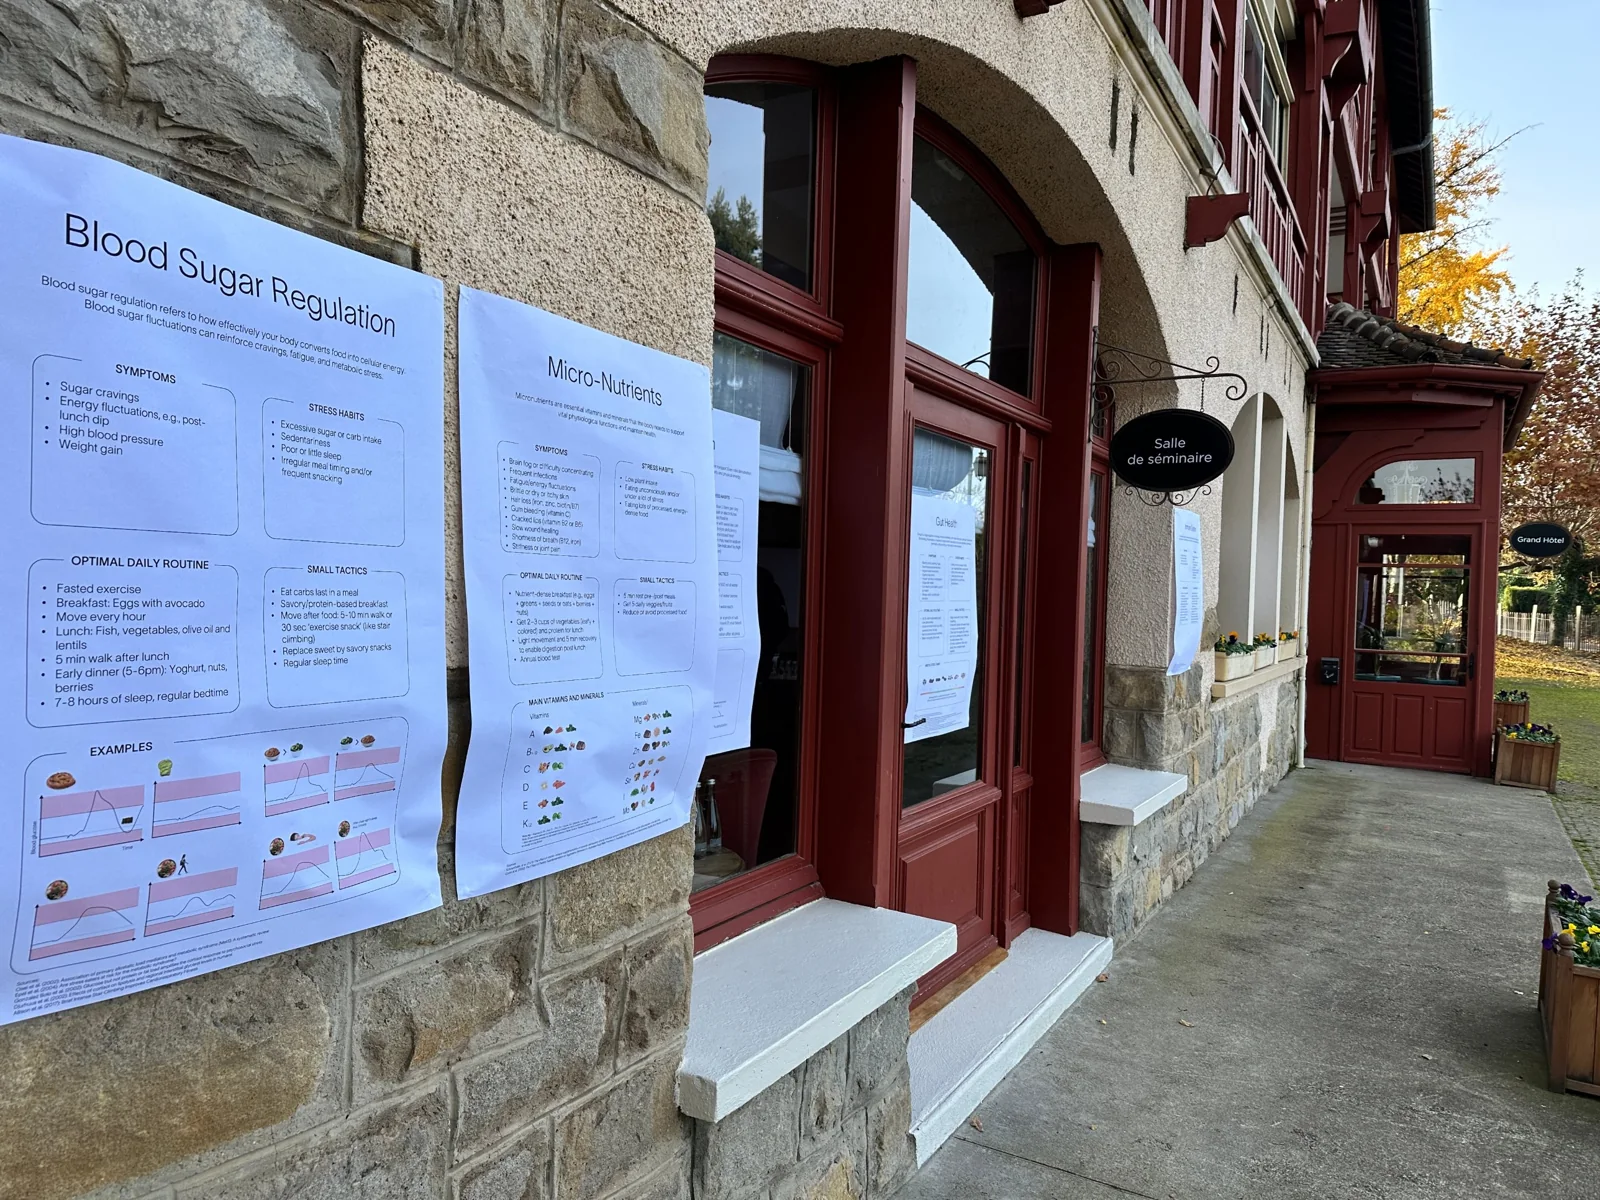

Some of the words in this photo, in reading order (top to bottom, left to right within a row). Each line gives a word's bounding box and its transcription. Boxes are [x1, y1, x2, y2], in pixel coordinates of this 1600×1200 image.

[65, 213, 168, 271] Blood
[179, 248, 264, 297] Sugar
[272, 276, 397, 338] Regulation
[42, 275, 75, 291] Blood
[78, 285, 108, 301] sugar
[110, 293, 157, 311] regulation
[160, 306, 186, 318] refers
[188, 311, 197, 321] to
[198, 313, 217, 326] how
[218, 320, 260, 339] effectively
[261, 332, 278, 343] your
[280, 334, 299, 348] body
[300, 342, 330, 355] converts
[332, 348, 346, 359] food
[85, 299, 115, 314] Blood
[117, 308, 144, 321] sugar
[146, 314, 197, 334] fluctuations
[199, 329, 215, 339] can
[217, 333, 253, 348] reinforce
[255, 342, 288, 357] cravings,
[318, 358, 331, 366] and
[332, 361, 362, 375] metabolic
[115, 364, 176, 384] SYMPTOMS
[548, 355, 662, 407] Micro-Nutrients
[60, 381, 93, 396] Sugar
[96, 389, 139, 402] cravings
[60, 396, 99, 412] Energy
[101, 402, 160, 420] fluctuations,
[183, 417, 205, 426] post-
[308, 403, 338, 416] STRESS
[338, 409, 365, 421] HABITS
[60, 410, 90, 423] lunch
[92, 415, 110, 427] dip
[60, 424, 85, 438] High
[88, 428, 118, 441] blood
[121, 434, 163, 446] pressure
[281, 420, 316, 434] Excessive
[317, 428, 336, 438] sugar
[346, 433, 361, 441] carb
[363, 434, 382, 444] intake
[280, 432, 331, 448] Sedentariness
[1154, 438, 1186, 449] Salle
[59, 439, 98, 453] Weight
[100, 446, 123, 455] gain
[281, 444, 298, 454] Poor
[308, 448, 322, 458] little
[323, 451, 341, 461] sleep
[535, 445, 568, 456] SYMPTOMS
[1127, 454, 1144, 465] de
[1148, 452, 1212, 464] séminaire
[281, 456, 311, 468] Irregular
[312, 462, 328, 470] meal
[329, 463, 349, 475] timing
[642, 463, 658, 471] STRESS
[282, 468, 311, 479] frequent
[312, 473, 342, 485] snacking
[71, 555, 124, 567] OPTIMAL
[127, 558, 160, 568] DAILY
[163, 559, 209, 570] ROUTINE
[307, 565, 334, 574] SMALL
[336, 566, 368, 575] TACTICS
[520, 571, 544, 580] OPTIMAL
[57, 583, 94, 594] Fasted
[96, 584, 141, 594] exercise
[281, 587, 292, 596] Eat
[293, 588, 314, 596] carbs
[315, 588, 328, 596] last
[56, 598, 110, 608] Breakfast:
[113, 598, 139, 609] Eggs
[142, 598, 162, 607] with
[165, 599, 205, 608] avocado
[56, 612, 87, 622] Move
[90, 614, 120, 622] every
[122, 612, 146, 621] hour
[281, 611, 302, 620] Move
[303, 611, 320, 619] after
[56, 626, 93, 636] Lunch:
[96, 626, 120, 636] Fish,
[122, 625, 180, 636] vegetables,
[182, 625, 202, 634] olive
[204, 625, 213, 633] oil
[215, 624, 230, 633] and
[281, 623, 291, 632] 30
[55, 640, 87, 650] lentils
[283, 646, 313, 656] Replace
[314, 646, 335, 654] sweet
[336, 645, 345, 654] by
[370, 643, 392, 651] snacks
[56, 654, 63, 664] 5
[66, 654, 86, 664] min
[88, 653, 112, 663] walk
[115, 653, 139, 662] after
[142, 652, 169, 661] lunch
[283, 658, 311, 668] Regular
[313, 658, 332, 667] sleep
[56, 668, 83, 680] Early
[85, 668, 120, 678] dinner
[169, 664, 206, 675] Yoghurt,
[208, 664, 227, 672] nuts,
[55, 682, 94, 693] berries
[55, 697, 75, 707] 7-8
[78, 696, 108, 706] hours
[111, 694, 122, 704] of
[124, 693, 155, 704] sleep,
[157, 690, 191, 702] regular
[193, 688, 228, 698] bedtime
[543, 696, 568, 704] VITAMINS
[580, 692, 604, 700] MINERALS
[90, 742, 153, 757] EXAMPLES
[524, 765, 530, 773] C
[523, 783, 529, 791] D
[523, 801, 528, 810] E
